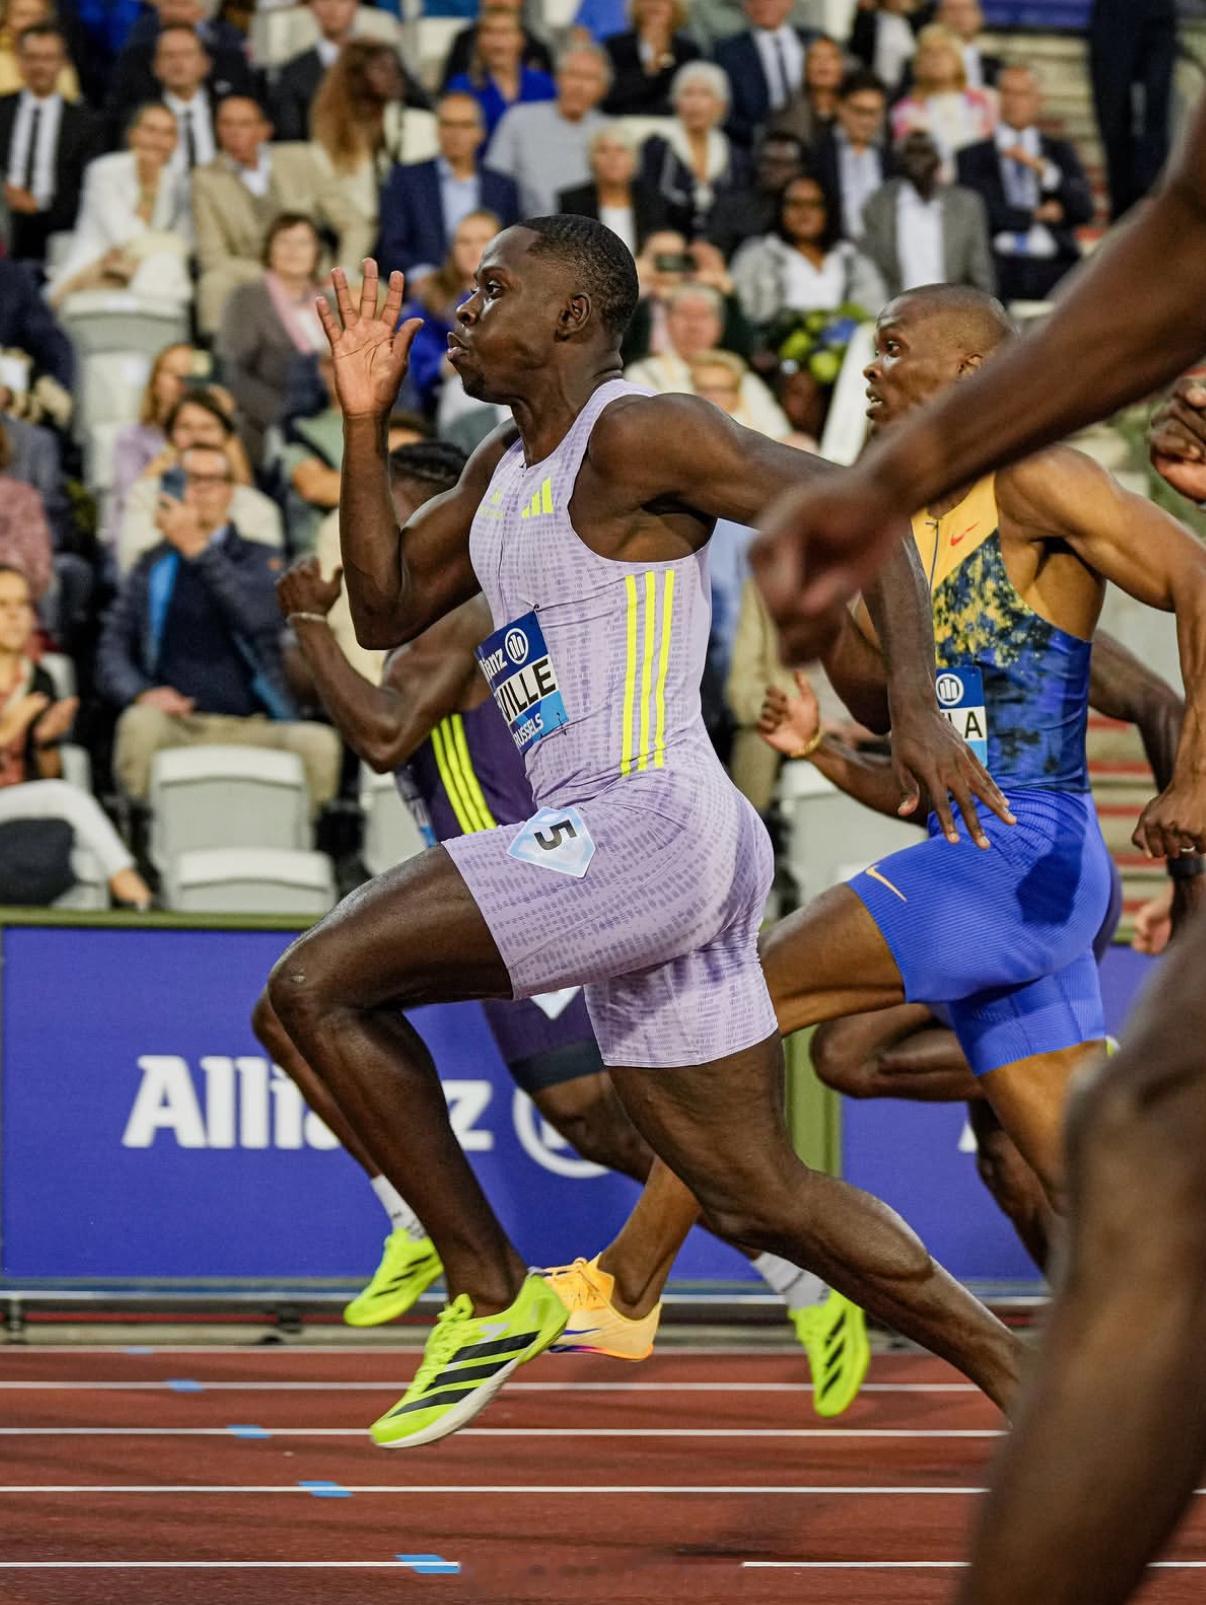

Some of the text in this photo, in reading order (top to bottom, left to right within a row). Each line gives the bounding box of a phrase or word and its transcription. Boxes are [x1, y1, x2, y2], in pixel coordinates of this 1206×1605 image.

[479, 648, 507, 681] ianz
[497, 658, 557, 722] VILLE
[513, 712, 544, 748] RUSSELS
[533, 819, 577, 851] 5
[121, 1055, 495, 1150] Alliz
